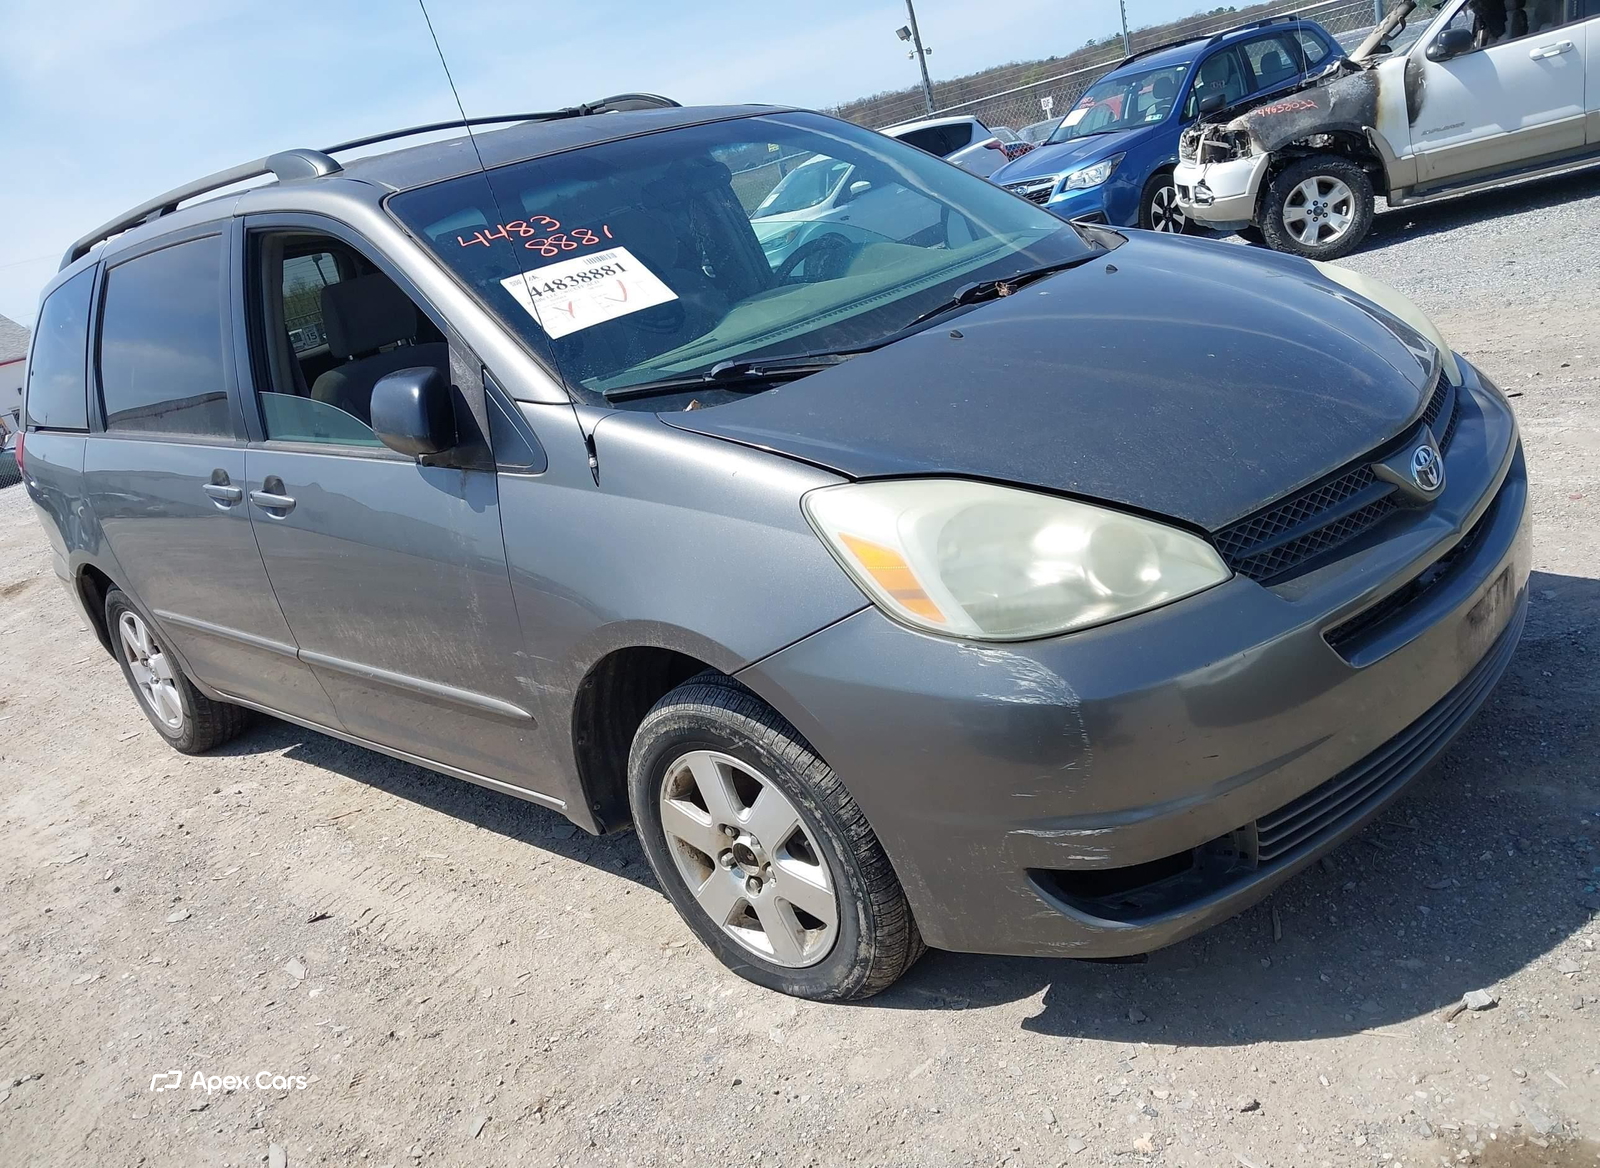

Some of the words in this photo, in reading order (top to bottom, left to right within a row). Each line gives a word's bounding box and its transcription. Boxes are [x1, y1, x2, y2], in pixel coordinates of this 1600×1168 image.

[457, 215, 560, 247] 4483
[525, 225, 613, 257] 8881
[530, 262, 628, 298] 44838881
